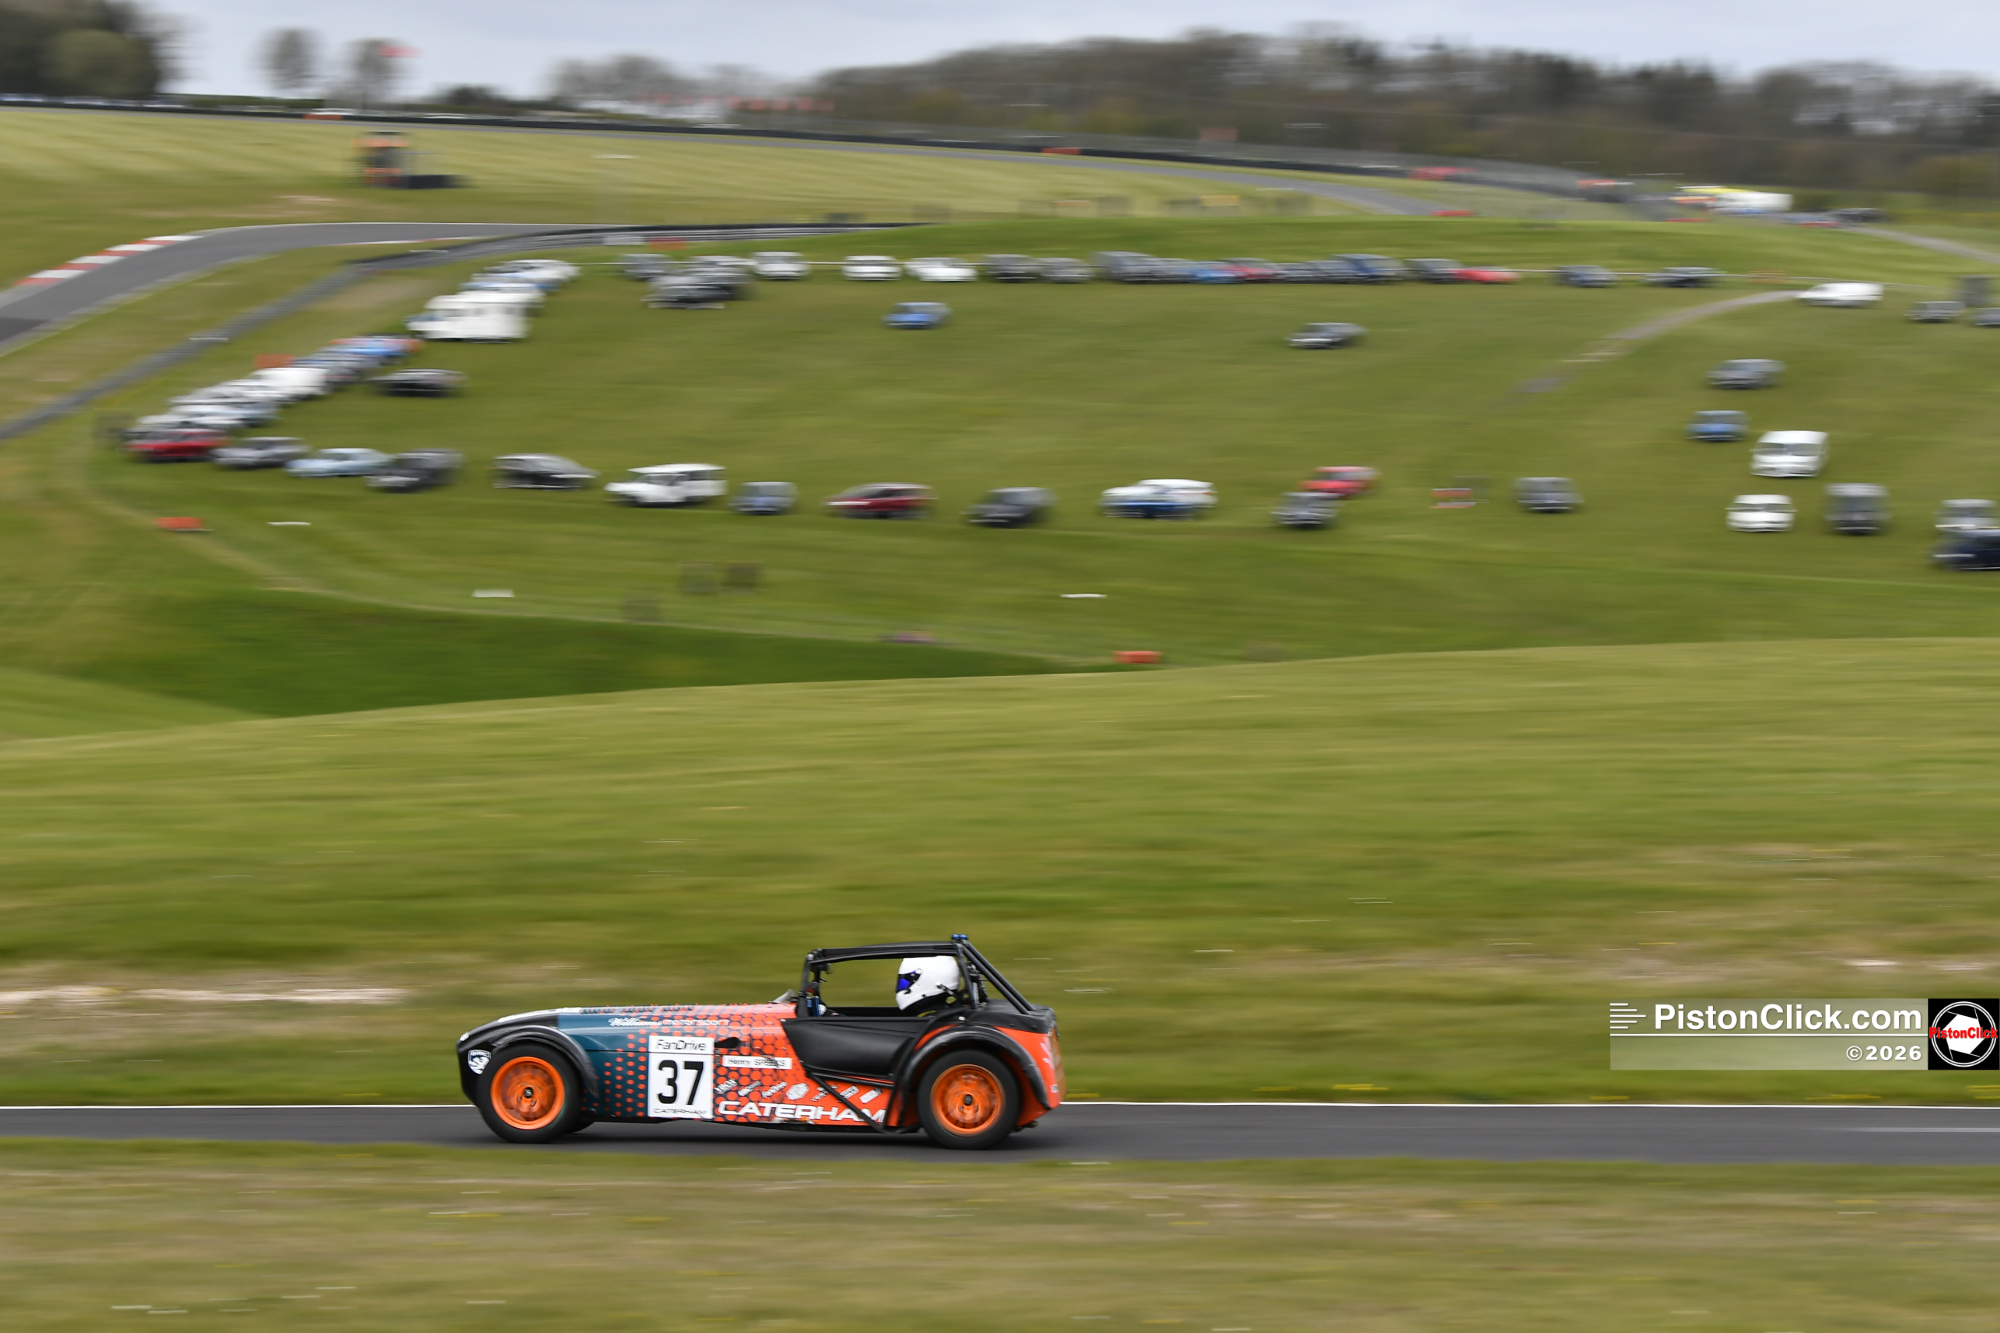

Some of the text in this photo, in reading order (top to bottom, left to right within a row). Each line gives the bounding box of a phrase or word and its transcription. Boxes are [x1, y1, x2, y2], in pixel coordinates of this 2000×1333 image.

[656, 1039, 706, 1051] FanDrive
[658, 1059, 704, 1105] 37
[718, 1101, 886, 1123] CATERHAM
